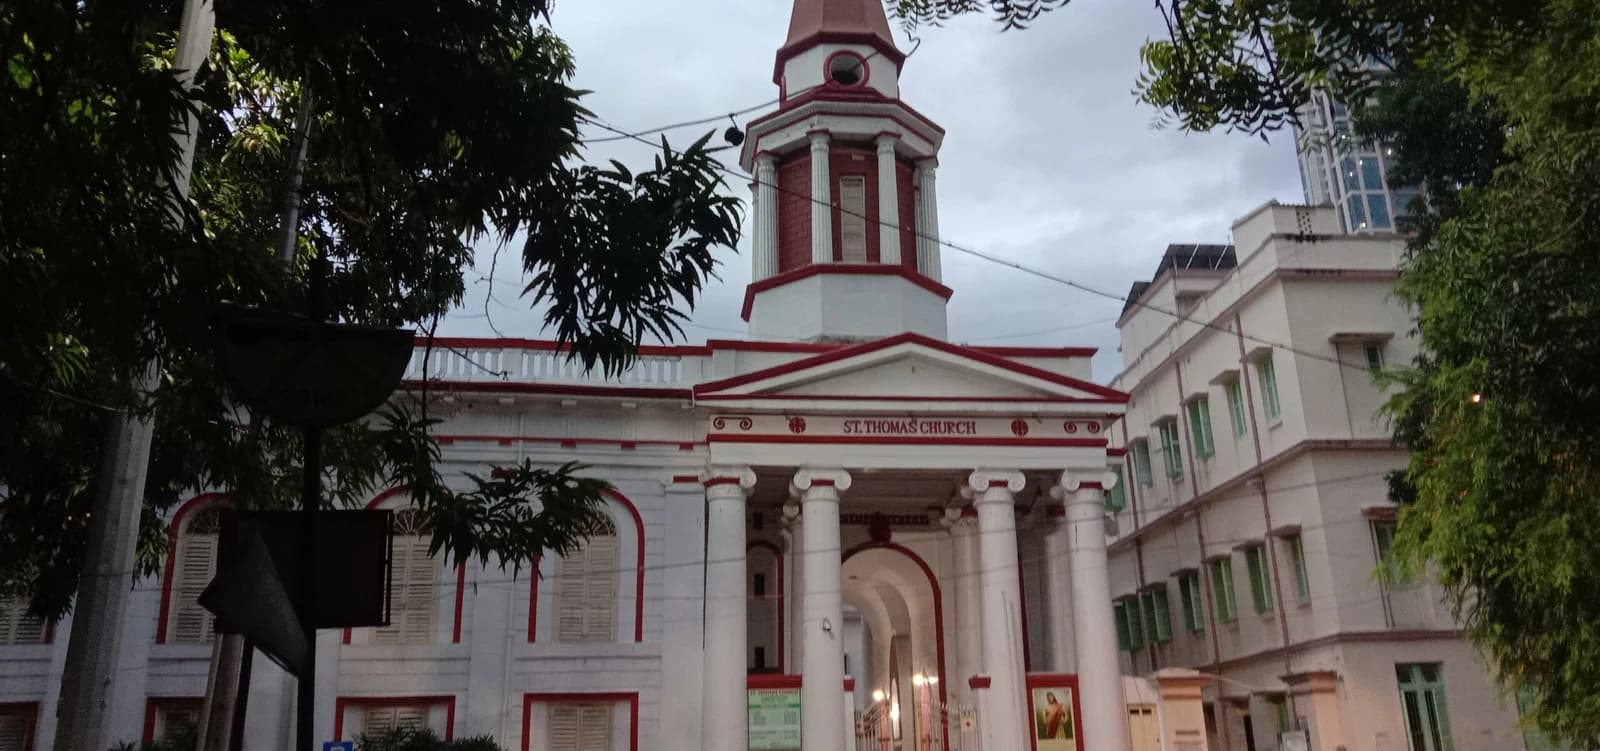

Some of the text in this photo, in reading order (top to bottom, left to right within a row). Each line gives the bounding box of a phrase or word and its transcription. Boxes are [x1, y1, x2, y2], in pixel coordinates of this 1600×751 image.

[843, 419, 976, 435] ST. THOMAS CHURCH
